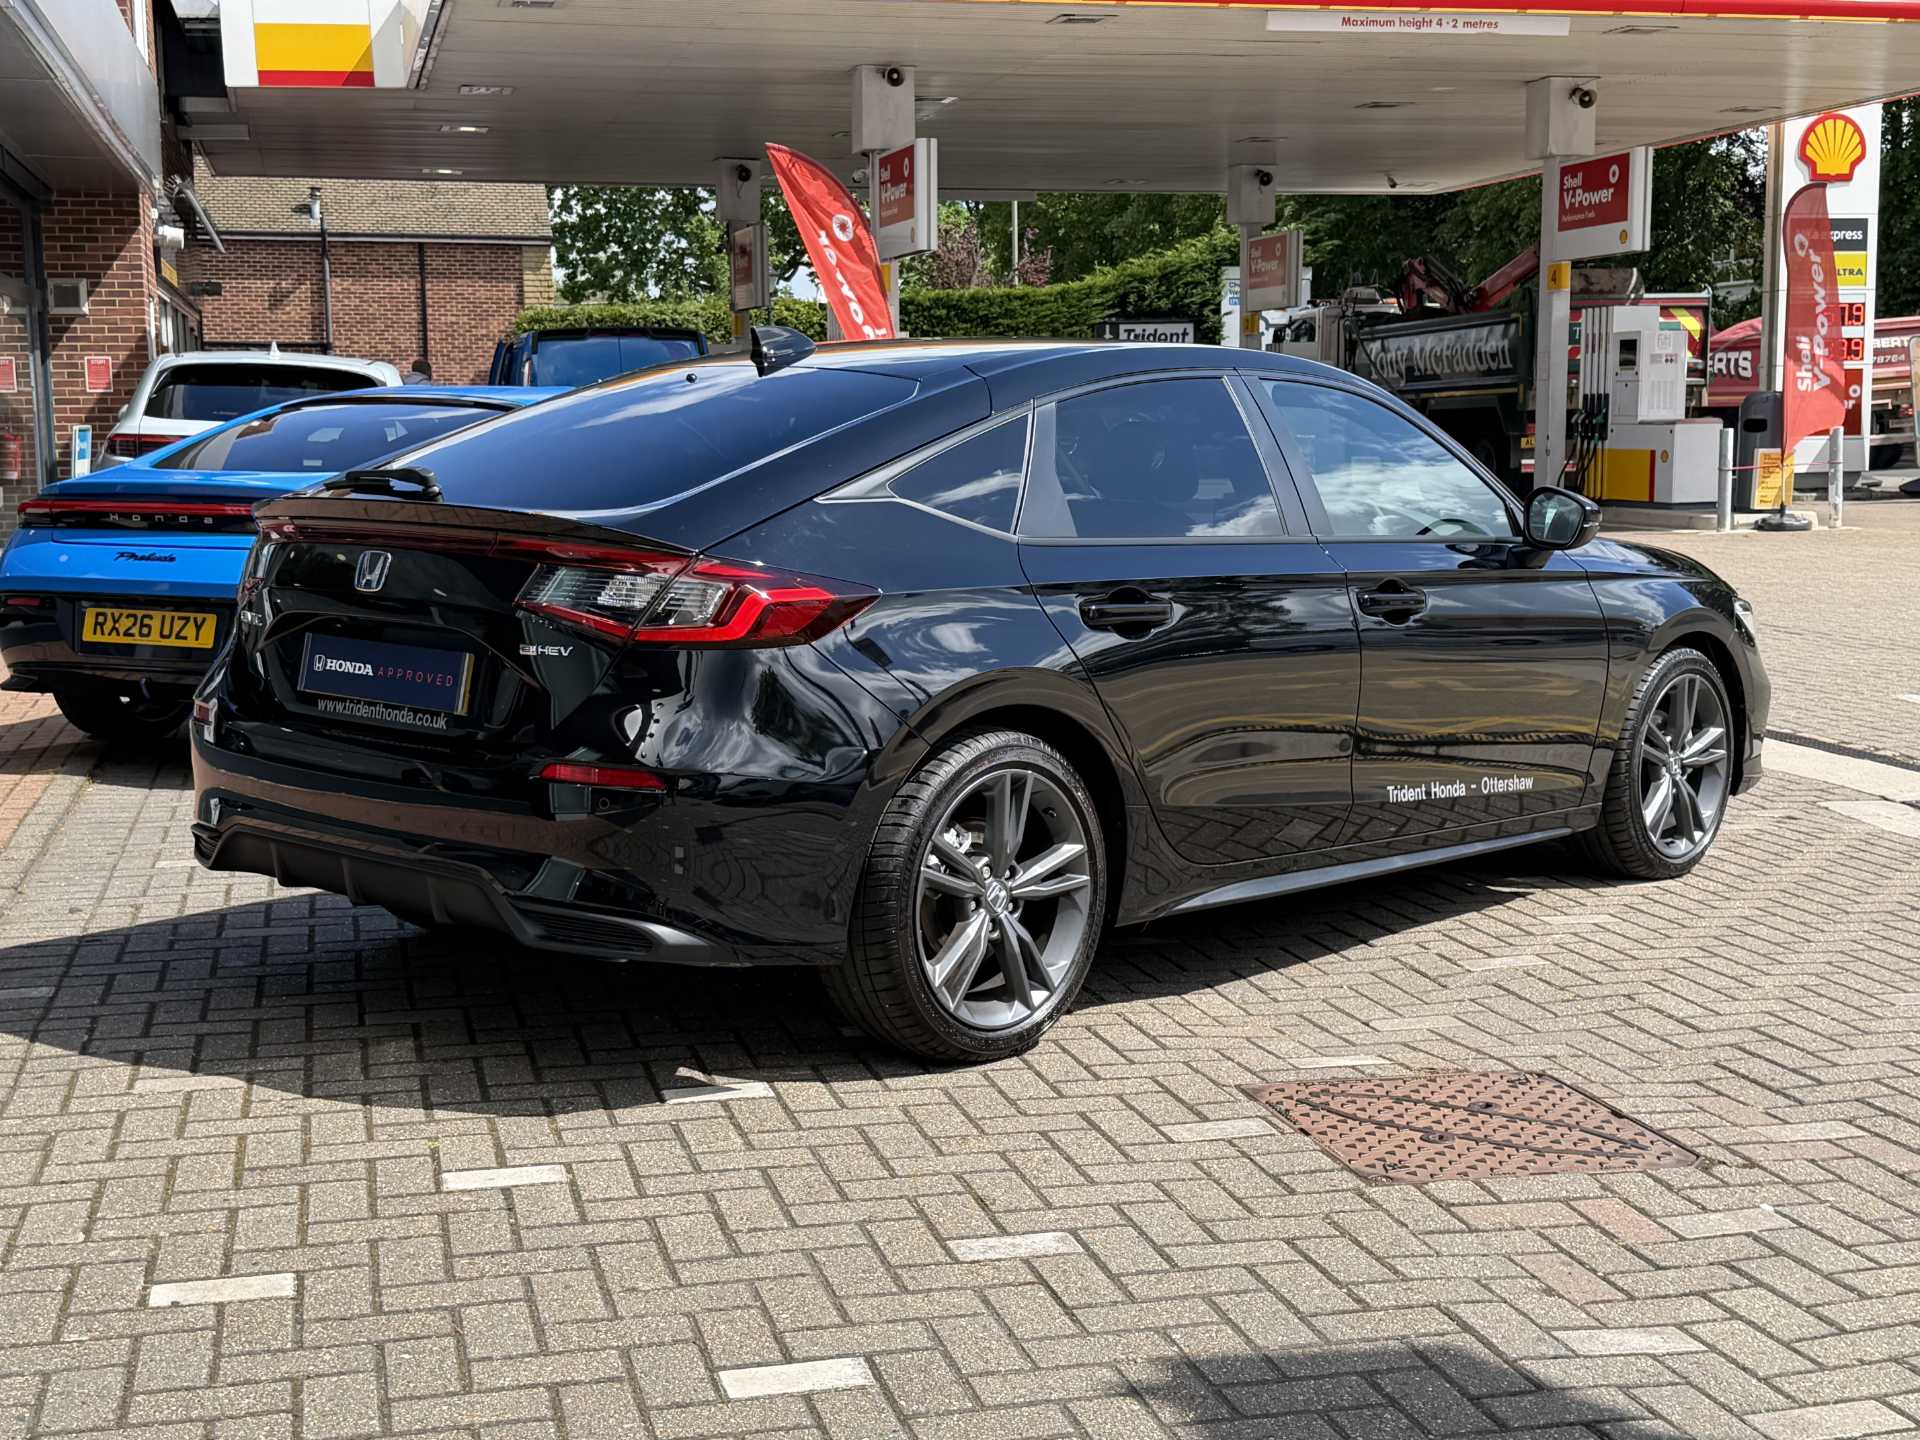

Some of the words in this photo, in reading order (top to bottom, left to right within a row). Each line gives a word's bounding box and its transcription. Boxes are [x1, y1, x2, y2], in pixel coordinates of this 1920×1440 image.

[1341, 16, 1396, 28] Maximum
[1399, 16, 1433, 30] height
[1462, 18, 1499, 29] metres
[1563, 172, 1583, 190] Shell
[1563, 187, 1615, 209] V-Power
[1551, 272, 1558, 285] 4
[1123, 328, 1190, 343] Trident
[1368, 340, 1408, 388] Tony
[1413, 326, 1514, 376] McFadden
[1796, 335, 1813, 393] Shell
[114, 551, 177, 563] Prelude
[93, 611, 154, 639] RX26
[159, 615, 207, 641] UZY
[326, 658, 374, 676] HONDA
[377, 666, 454, 687] APPROVED
[317, 698, 447, 729] www.tridenthonda.co.uk
[1387, 784, 1427, 803] Trident
[1431, 780, 1466, 799] Honda
[1481, 774, 1534, 794] Ottershaw
